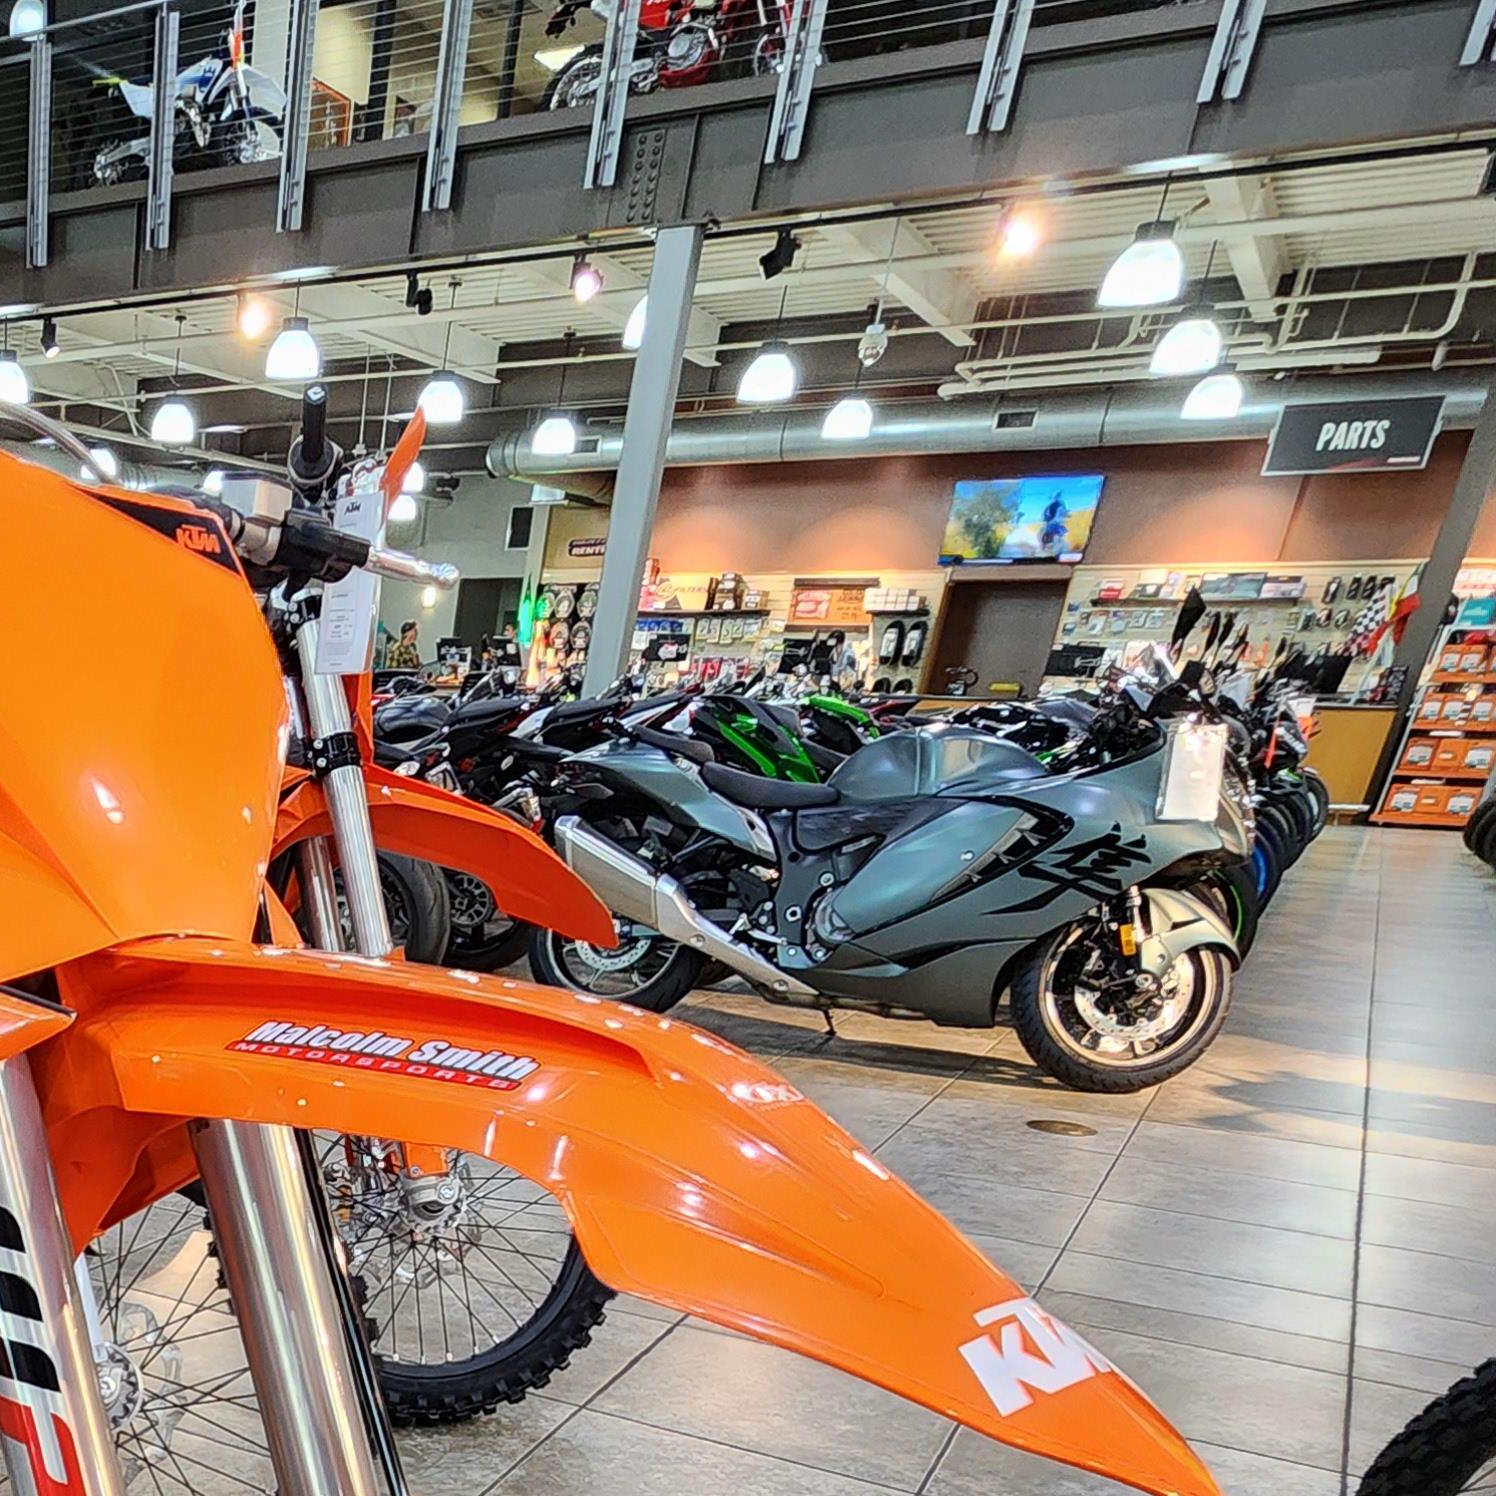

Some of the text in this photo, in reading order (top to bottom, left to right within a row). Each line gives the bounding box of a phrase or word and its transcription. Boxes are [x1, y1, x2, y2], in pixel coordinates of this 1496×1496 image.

[1315, 420, 1391, 451] PARTS
[175, 523, 222, 554] KTM
[234, 1042, 515, 1090] MOTORSPORTS
[244, 1020, 542, 1081] Malcolm Smith
